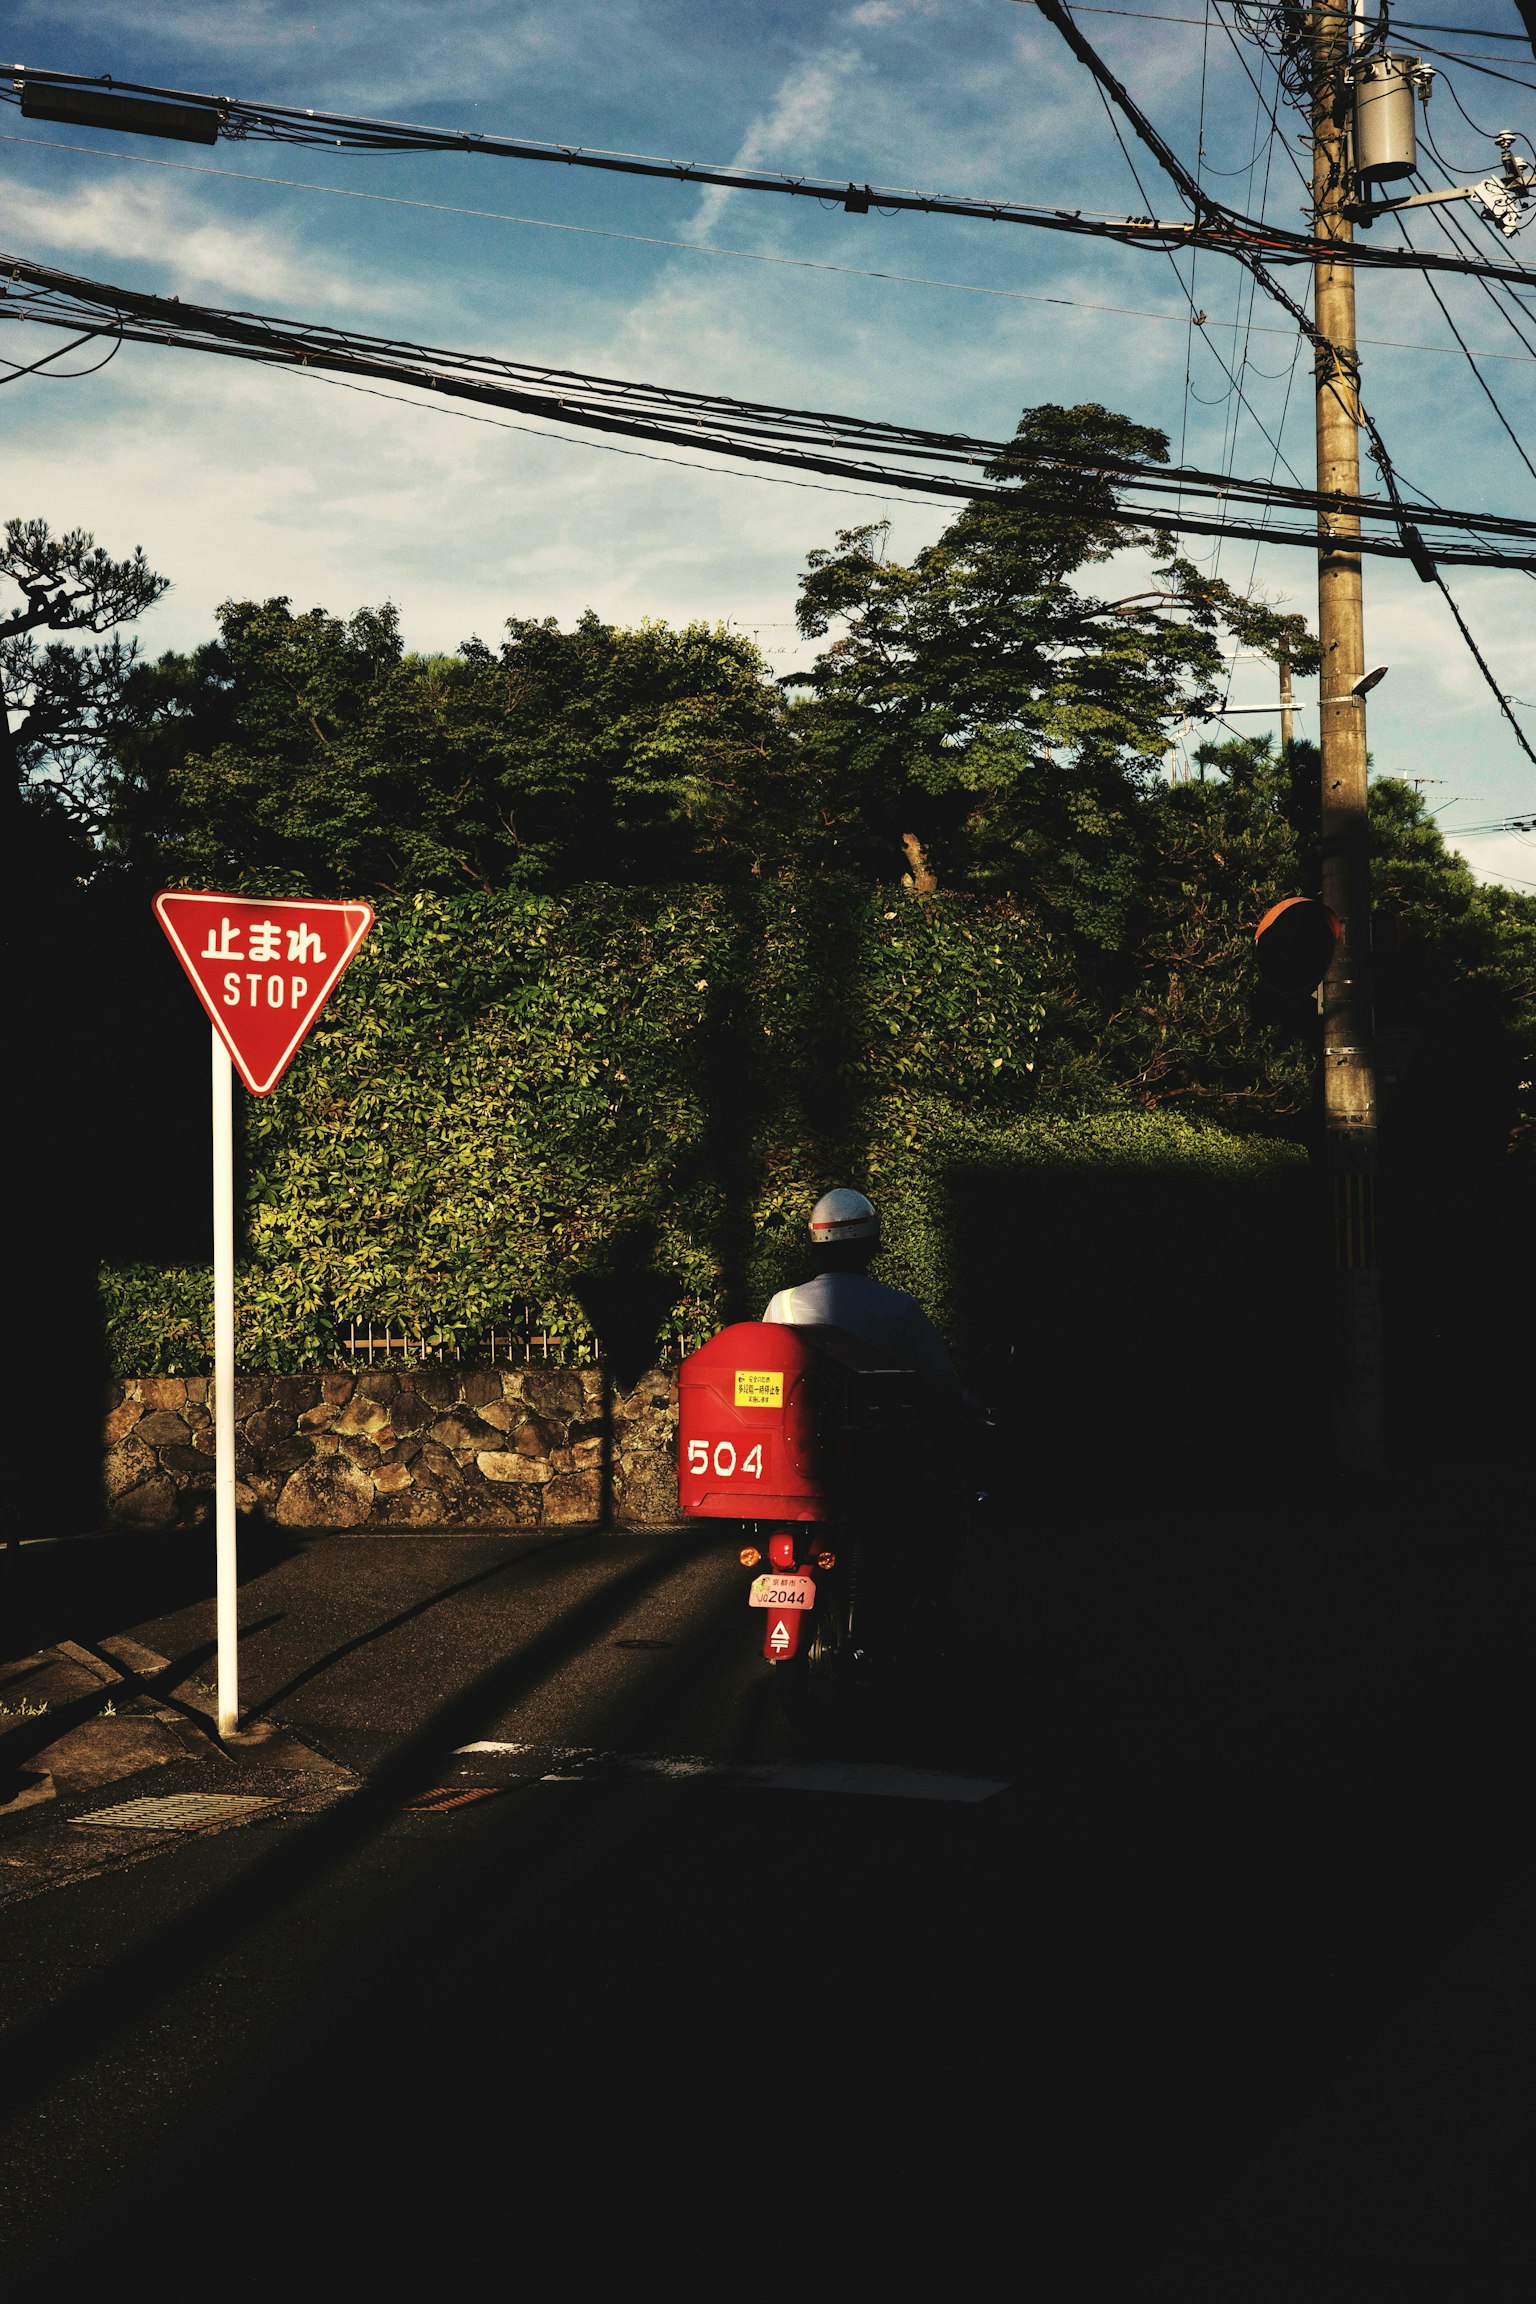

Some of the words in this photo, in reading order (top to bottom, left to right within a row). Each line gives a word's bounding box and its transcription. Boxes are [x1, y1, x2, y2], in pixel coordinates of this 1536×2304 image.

[201, 917, 327, 964] 止まれ
[223, 972, 308, 1009] STOP
[688, 1440, 763, 1479] 504
[769, 1590, 805, 1604] 2044
[772, 1579, 796, 1587] 京都市
